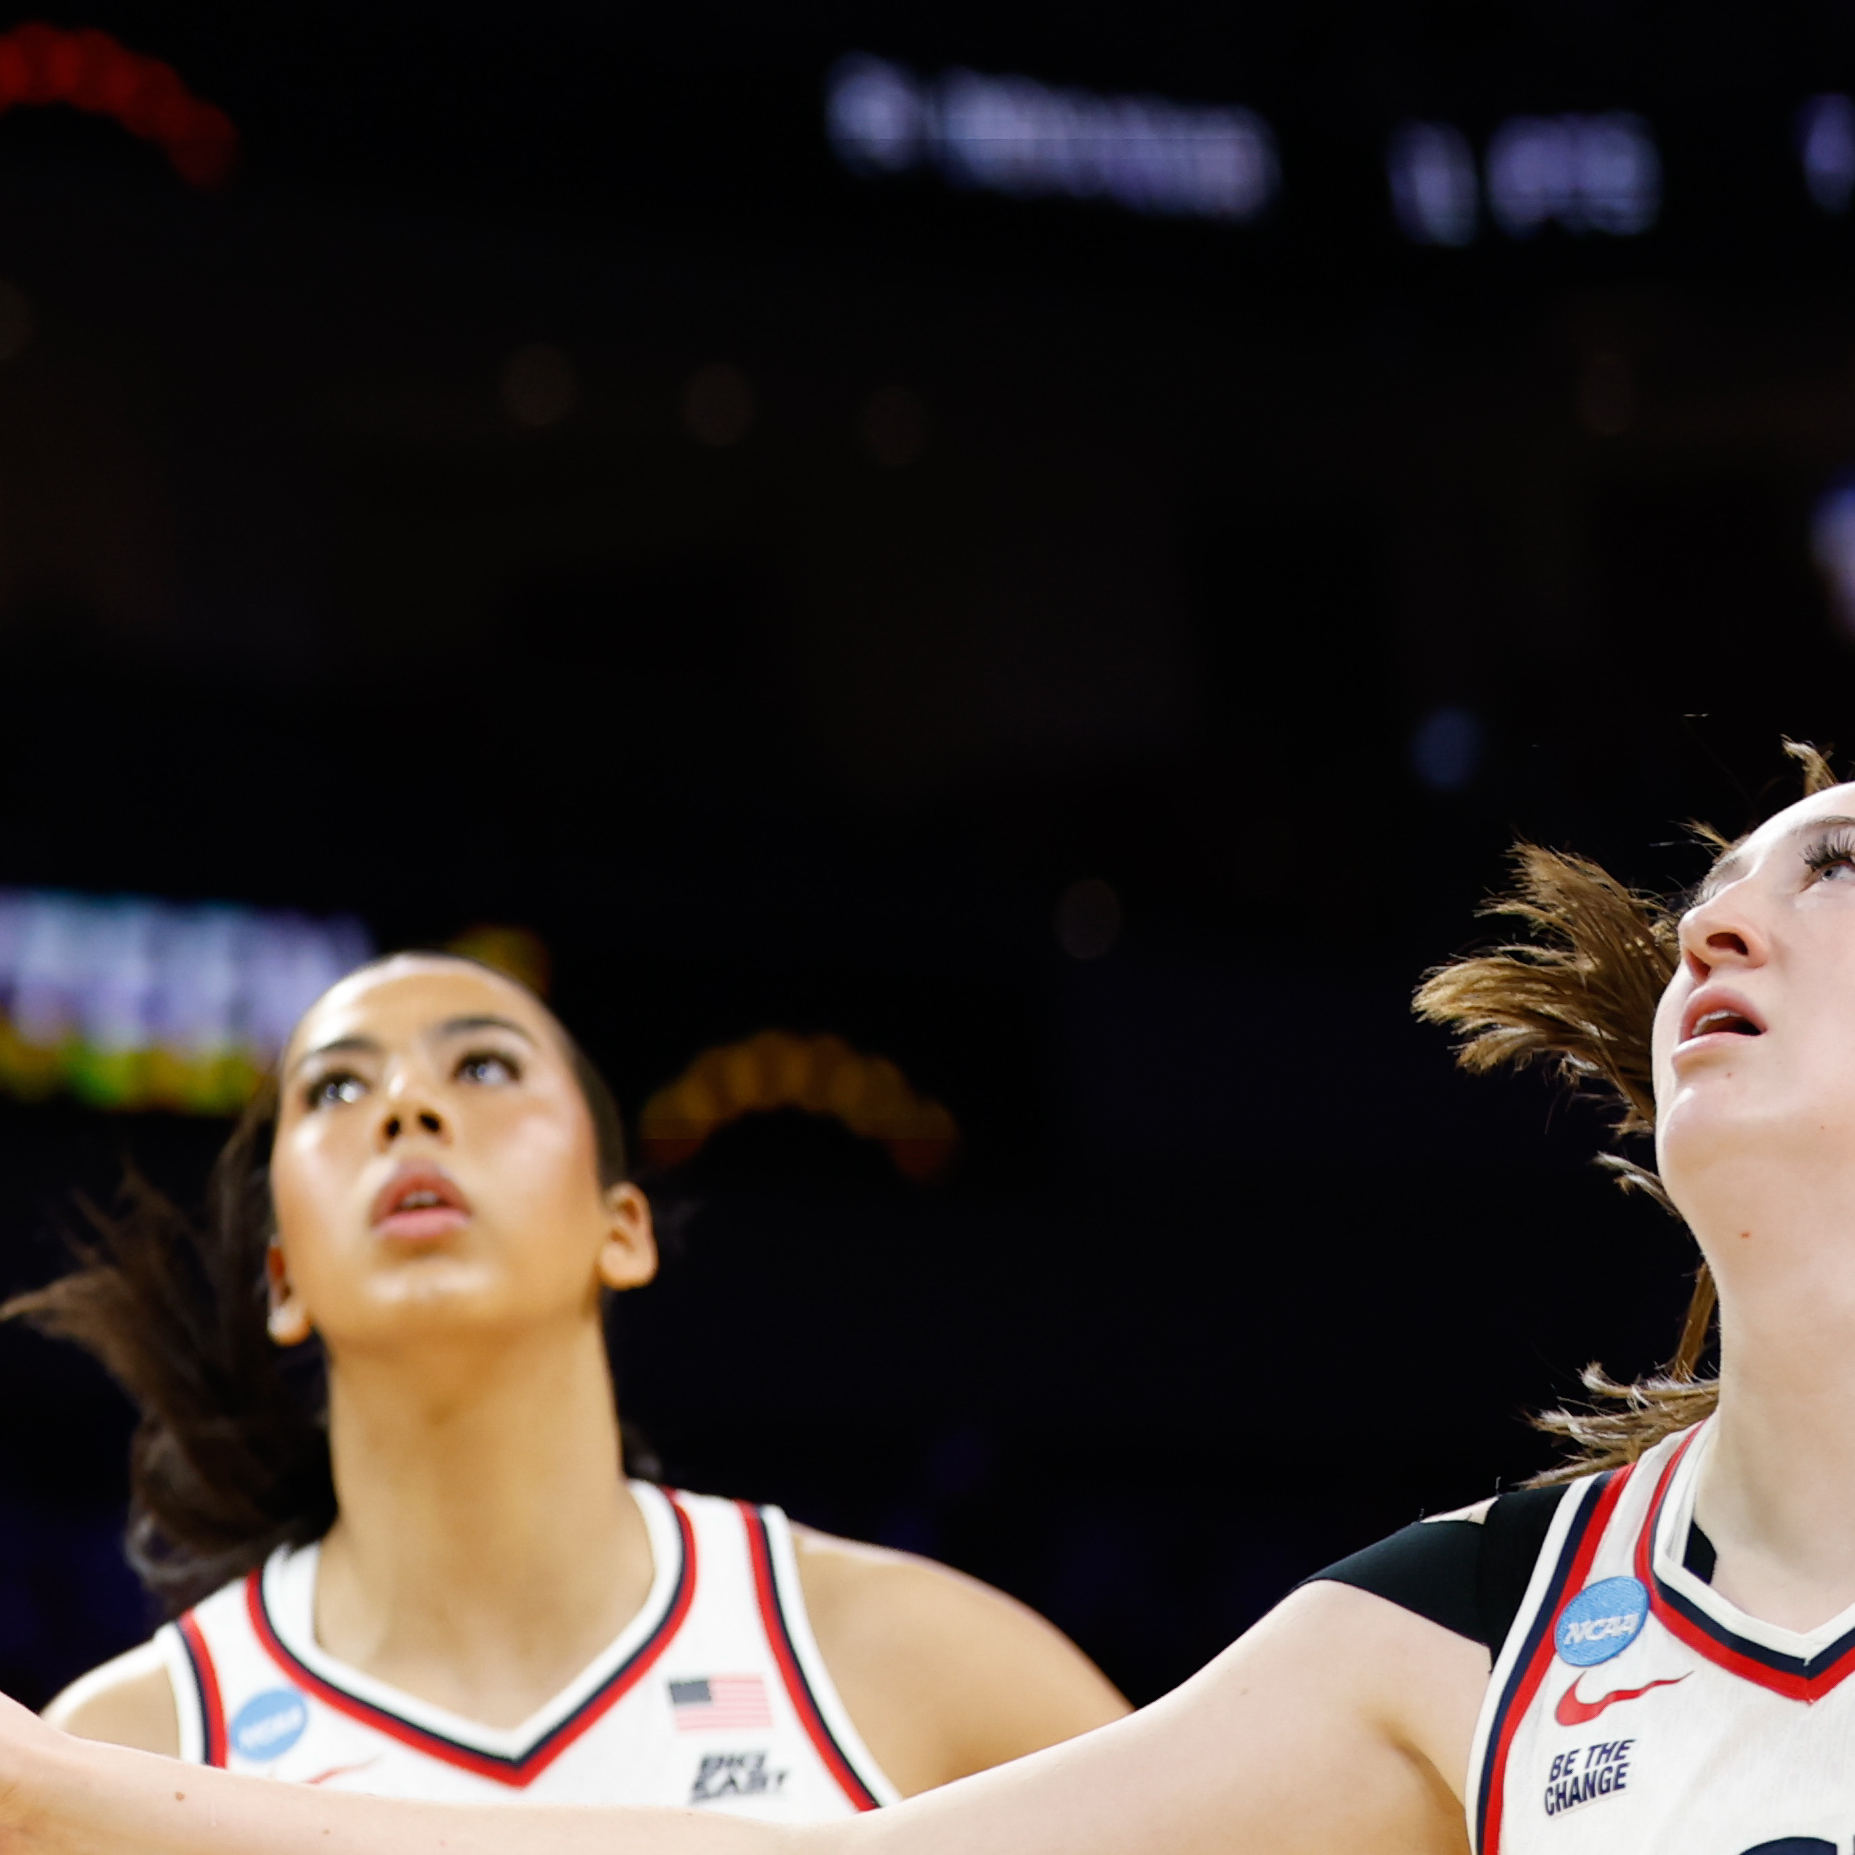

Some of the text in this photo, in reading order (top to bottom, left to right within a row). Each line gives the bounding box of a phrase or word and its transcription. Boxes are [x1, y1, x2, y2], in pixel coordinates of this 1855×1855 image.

[1563, 1613, 1640, 1645] NCAA
[1548, 1738, 1637, 1783] BE THE
[1544, 1762, 1631, 1817] CHANGE
